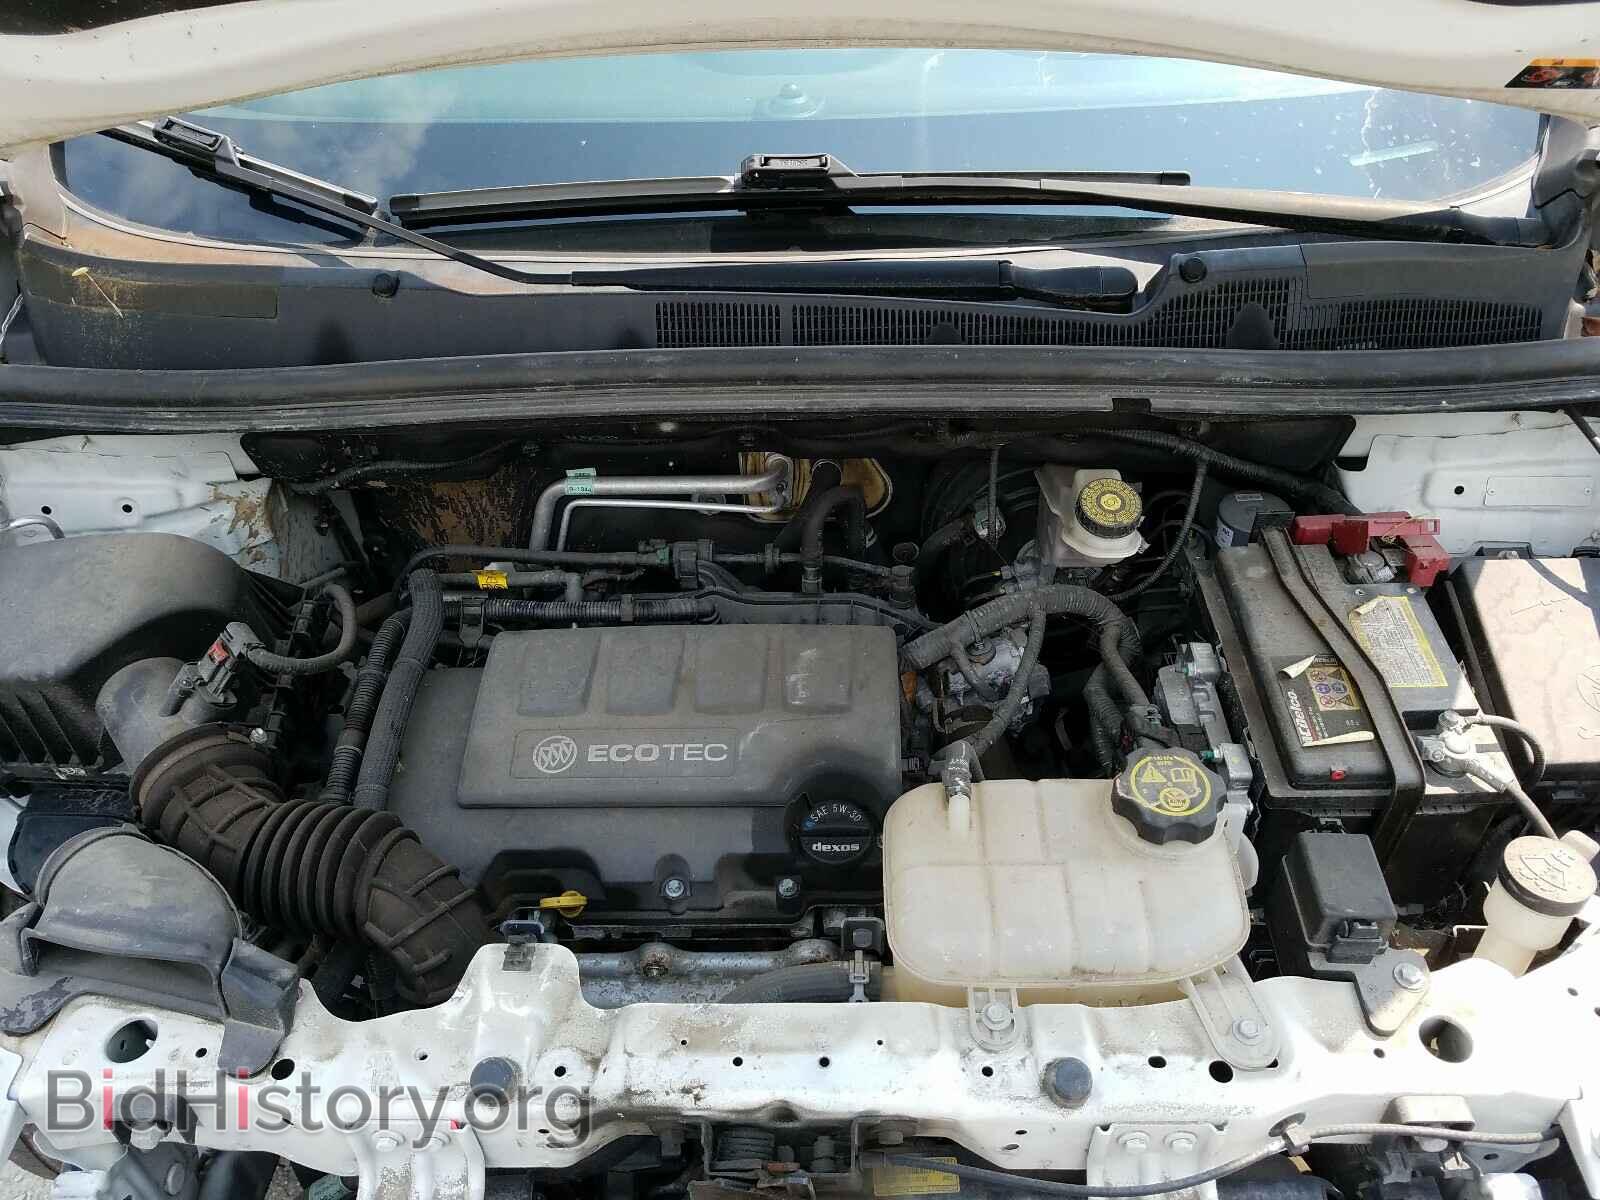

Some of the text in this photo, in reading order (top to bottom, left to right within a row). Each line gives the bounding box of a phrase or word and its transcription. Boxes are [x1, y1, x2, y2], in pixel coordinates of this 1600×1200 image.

[587, 743, 729, 762] ECOTEC
[810, 803, 863, 822] SAE 5W-30
[811, 841, 860, 852] dexos
